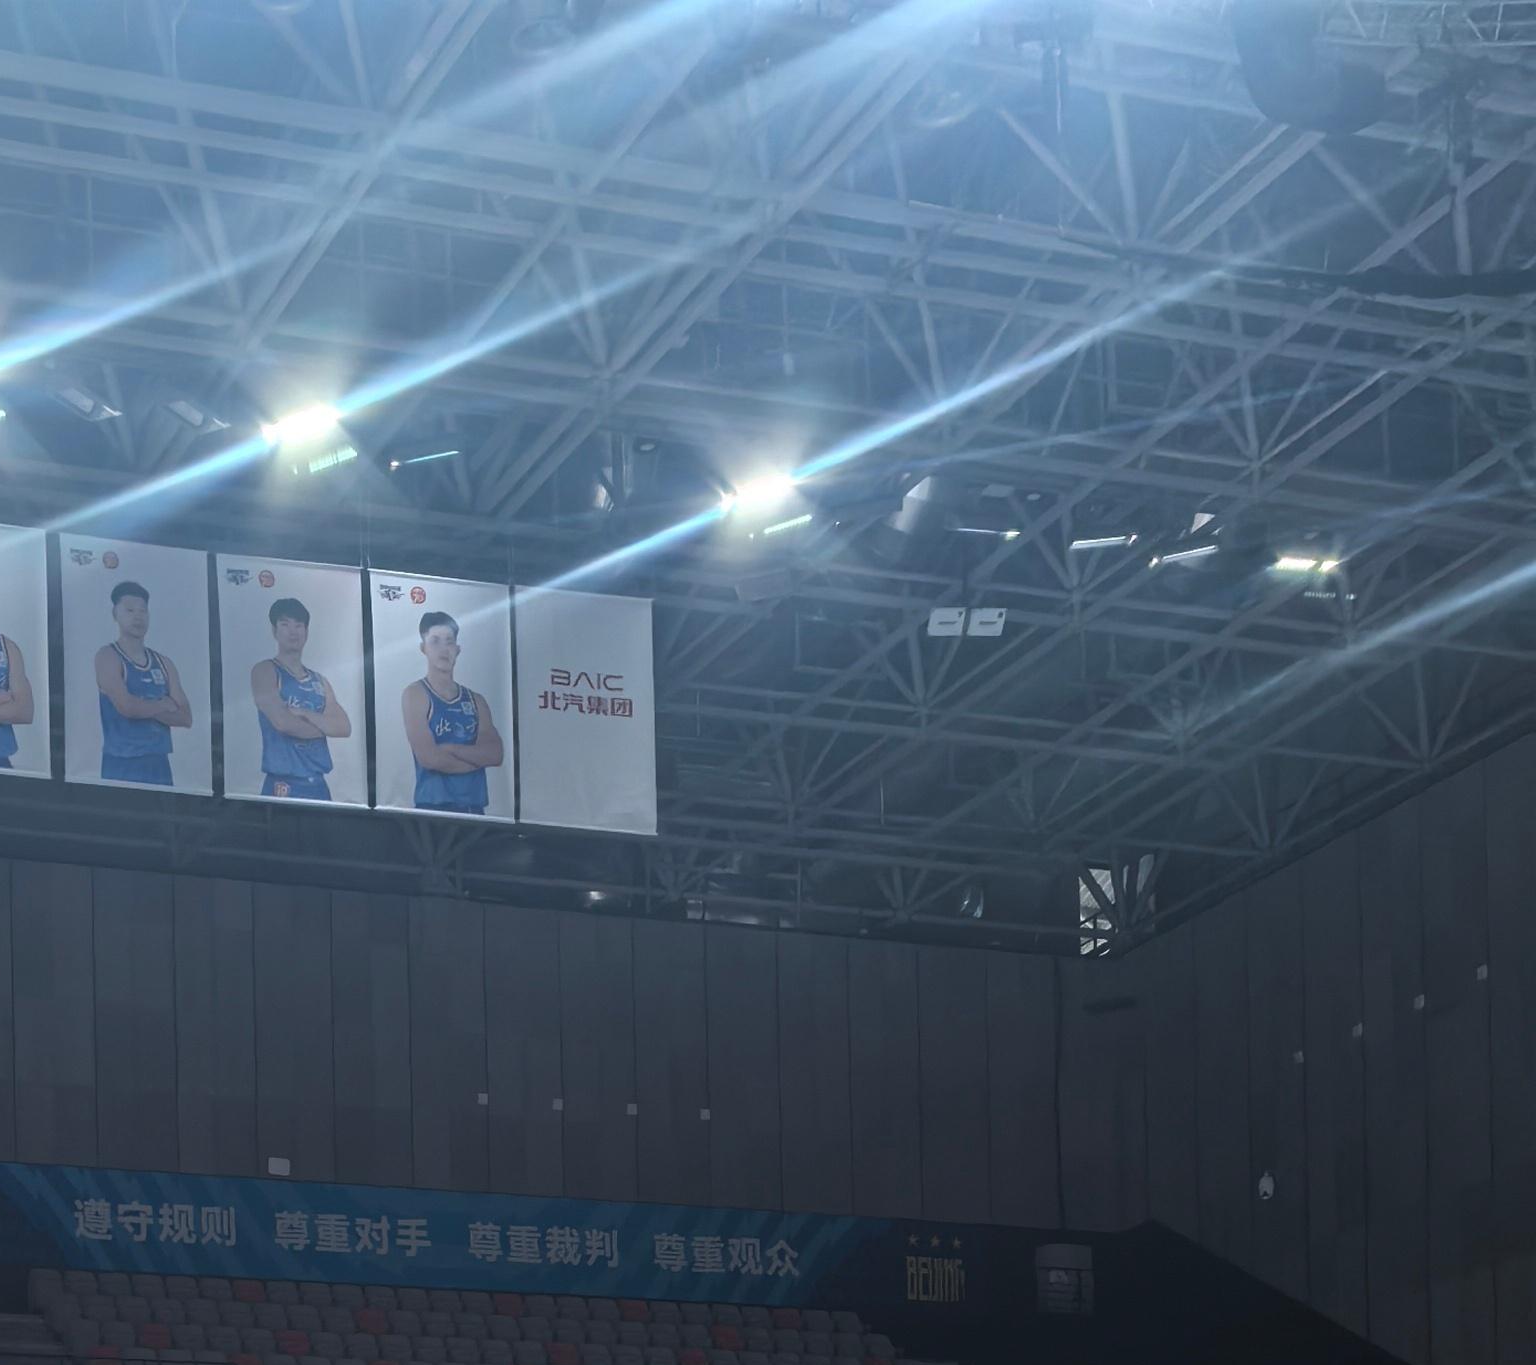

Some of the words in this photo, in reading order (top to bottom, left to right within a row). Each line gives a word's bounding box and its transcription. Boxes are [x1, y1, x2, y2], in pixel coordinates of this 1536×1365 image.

[550, 668, 625, 691] BAIC
[537, 690, 634, 718] 北汽集团
[73, 1198, 238, 1247] 遵守规则
[274, 1210, 431, 1257] 尊重对手
[467, 1221, 620, 1268] 尊重裁判
[653, 1233, 801, 1278] 尊重观众
